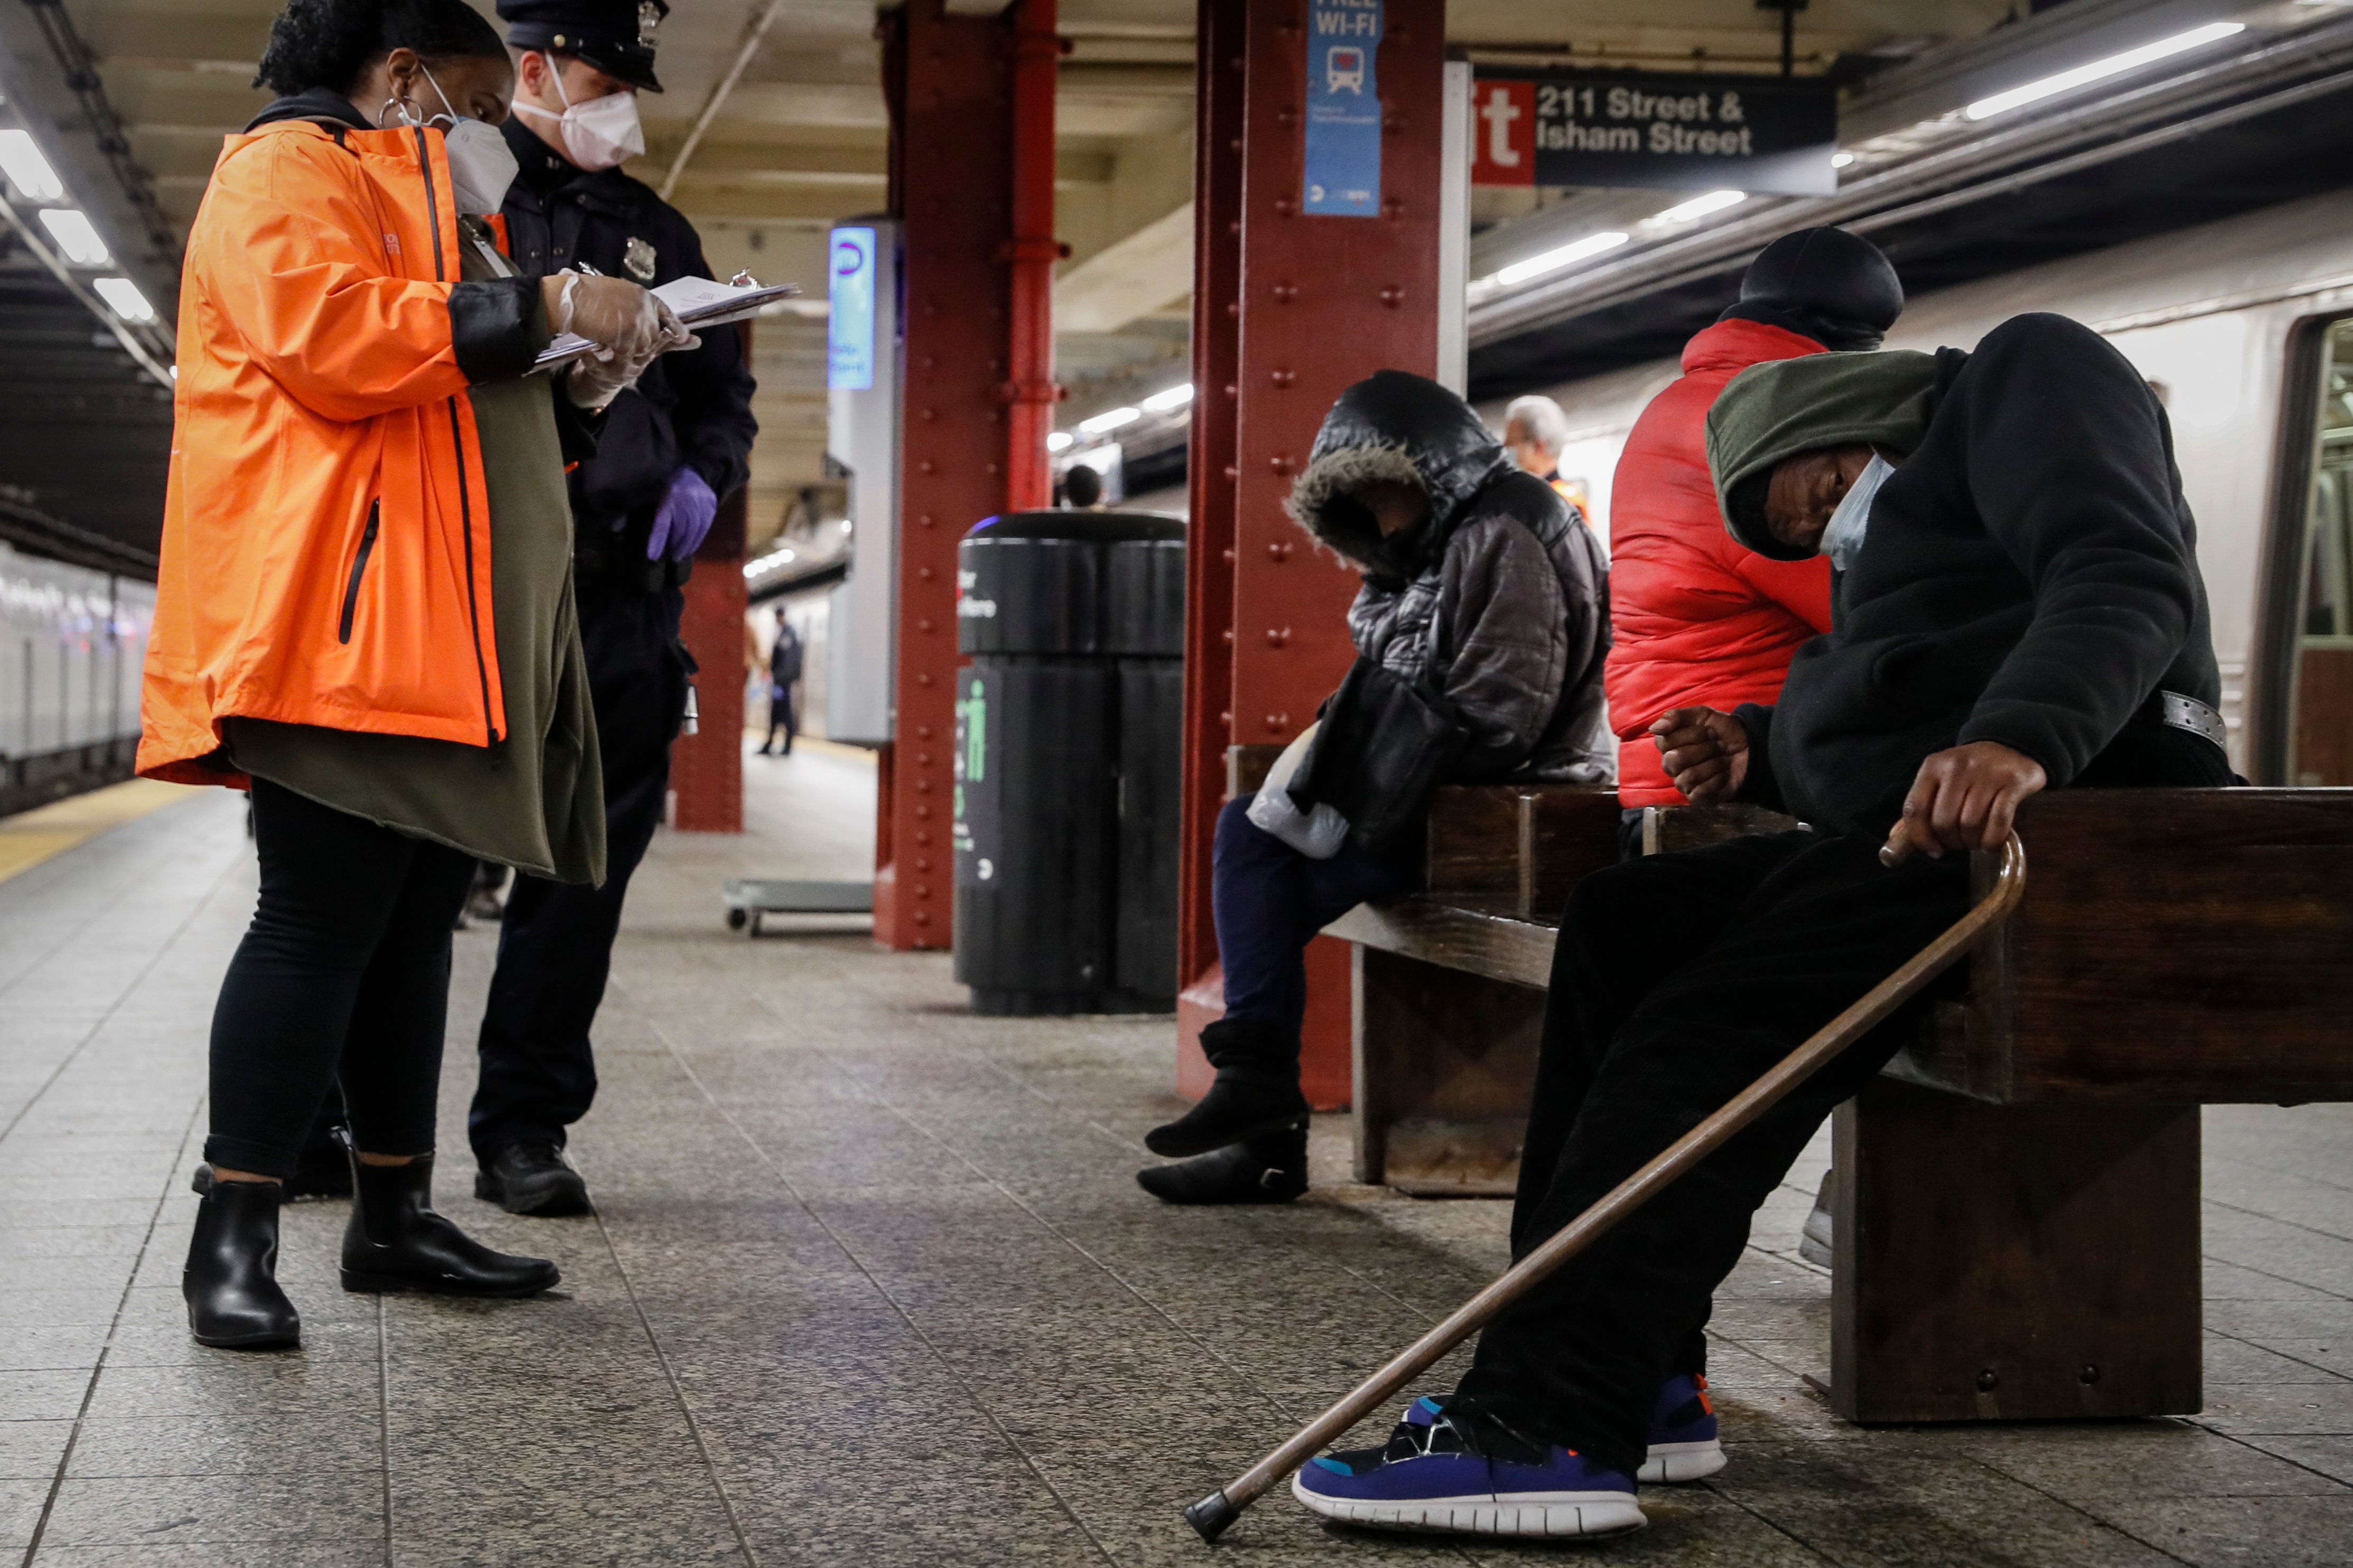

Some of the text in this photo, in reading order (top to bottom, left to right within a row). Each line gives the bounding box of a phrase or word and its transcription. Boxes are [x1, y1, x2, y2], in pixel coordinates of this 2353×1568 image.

[1316, 11, 1376, 36] WI-FI
[1536, 84, 1744, 122] 211 Street &
[1536, 119, 1753, 155] Isham Street
